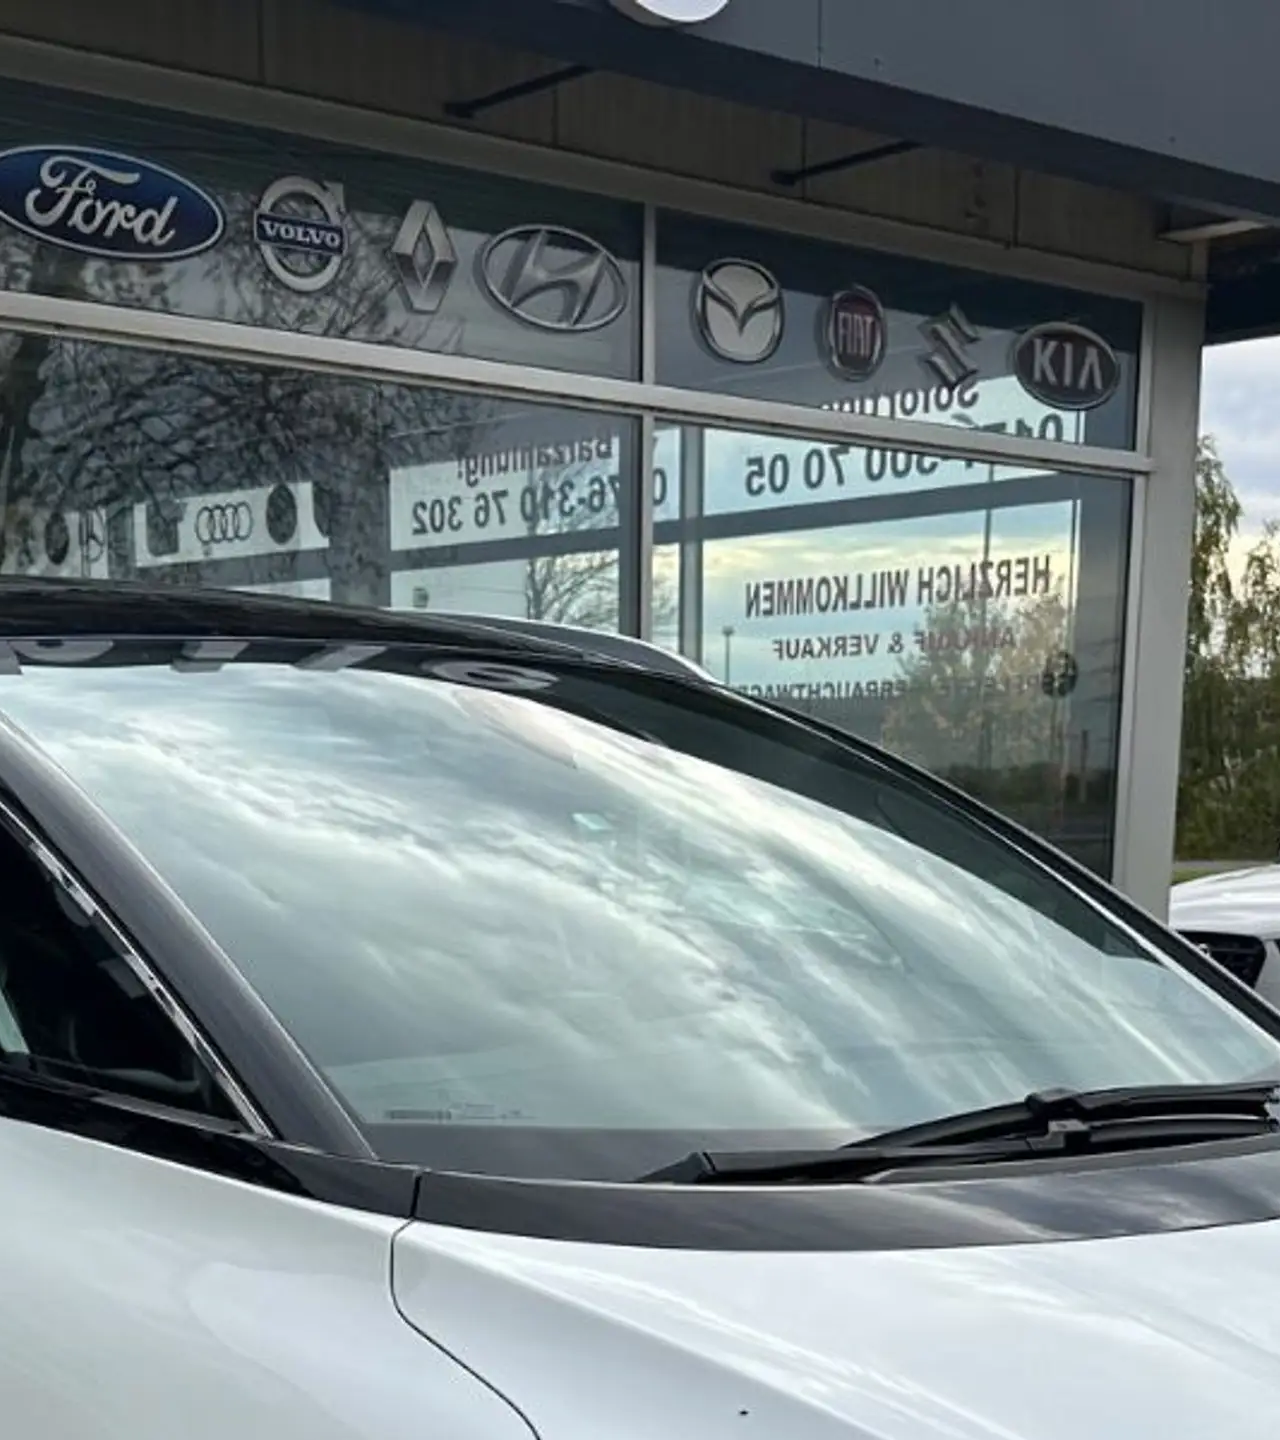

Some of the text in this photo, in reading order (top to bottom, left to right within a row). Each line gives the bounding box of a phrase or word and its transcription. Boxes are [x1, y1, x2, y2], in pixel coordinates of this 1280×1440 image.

[23, 155, 179, 247] Ford
[259, 218, 342, 248] VOLVO
[838, 311, 876, 358] FIAT
[1032, 337, 1104, 392] KIA
